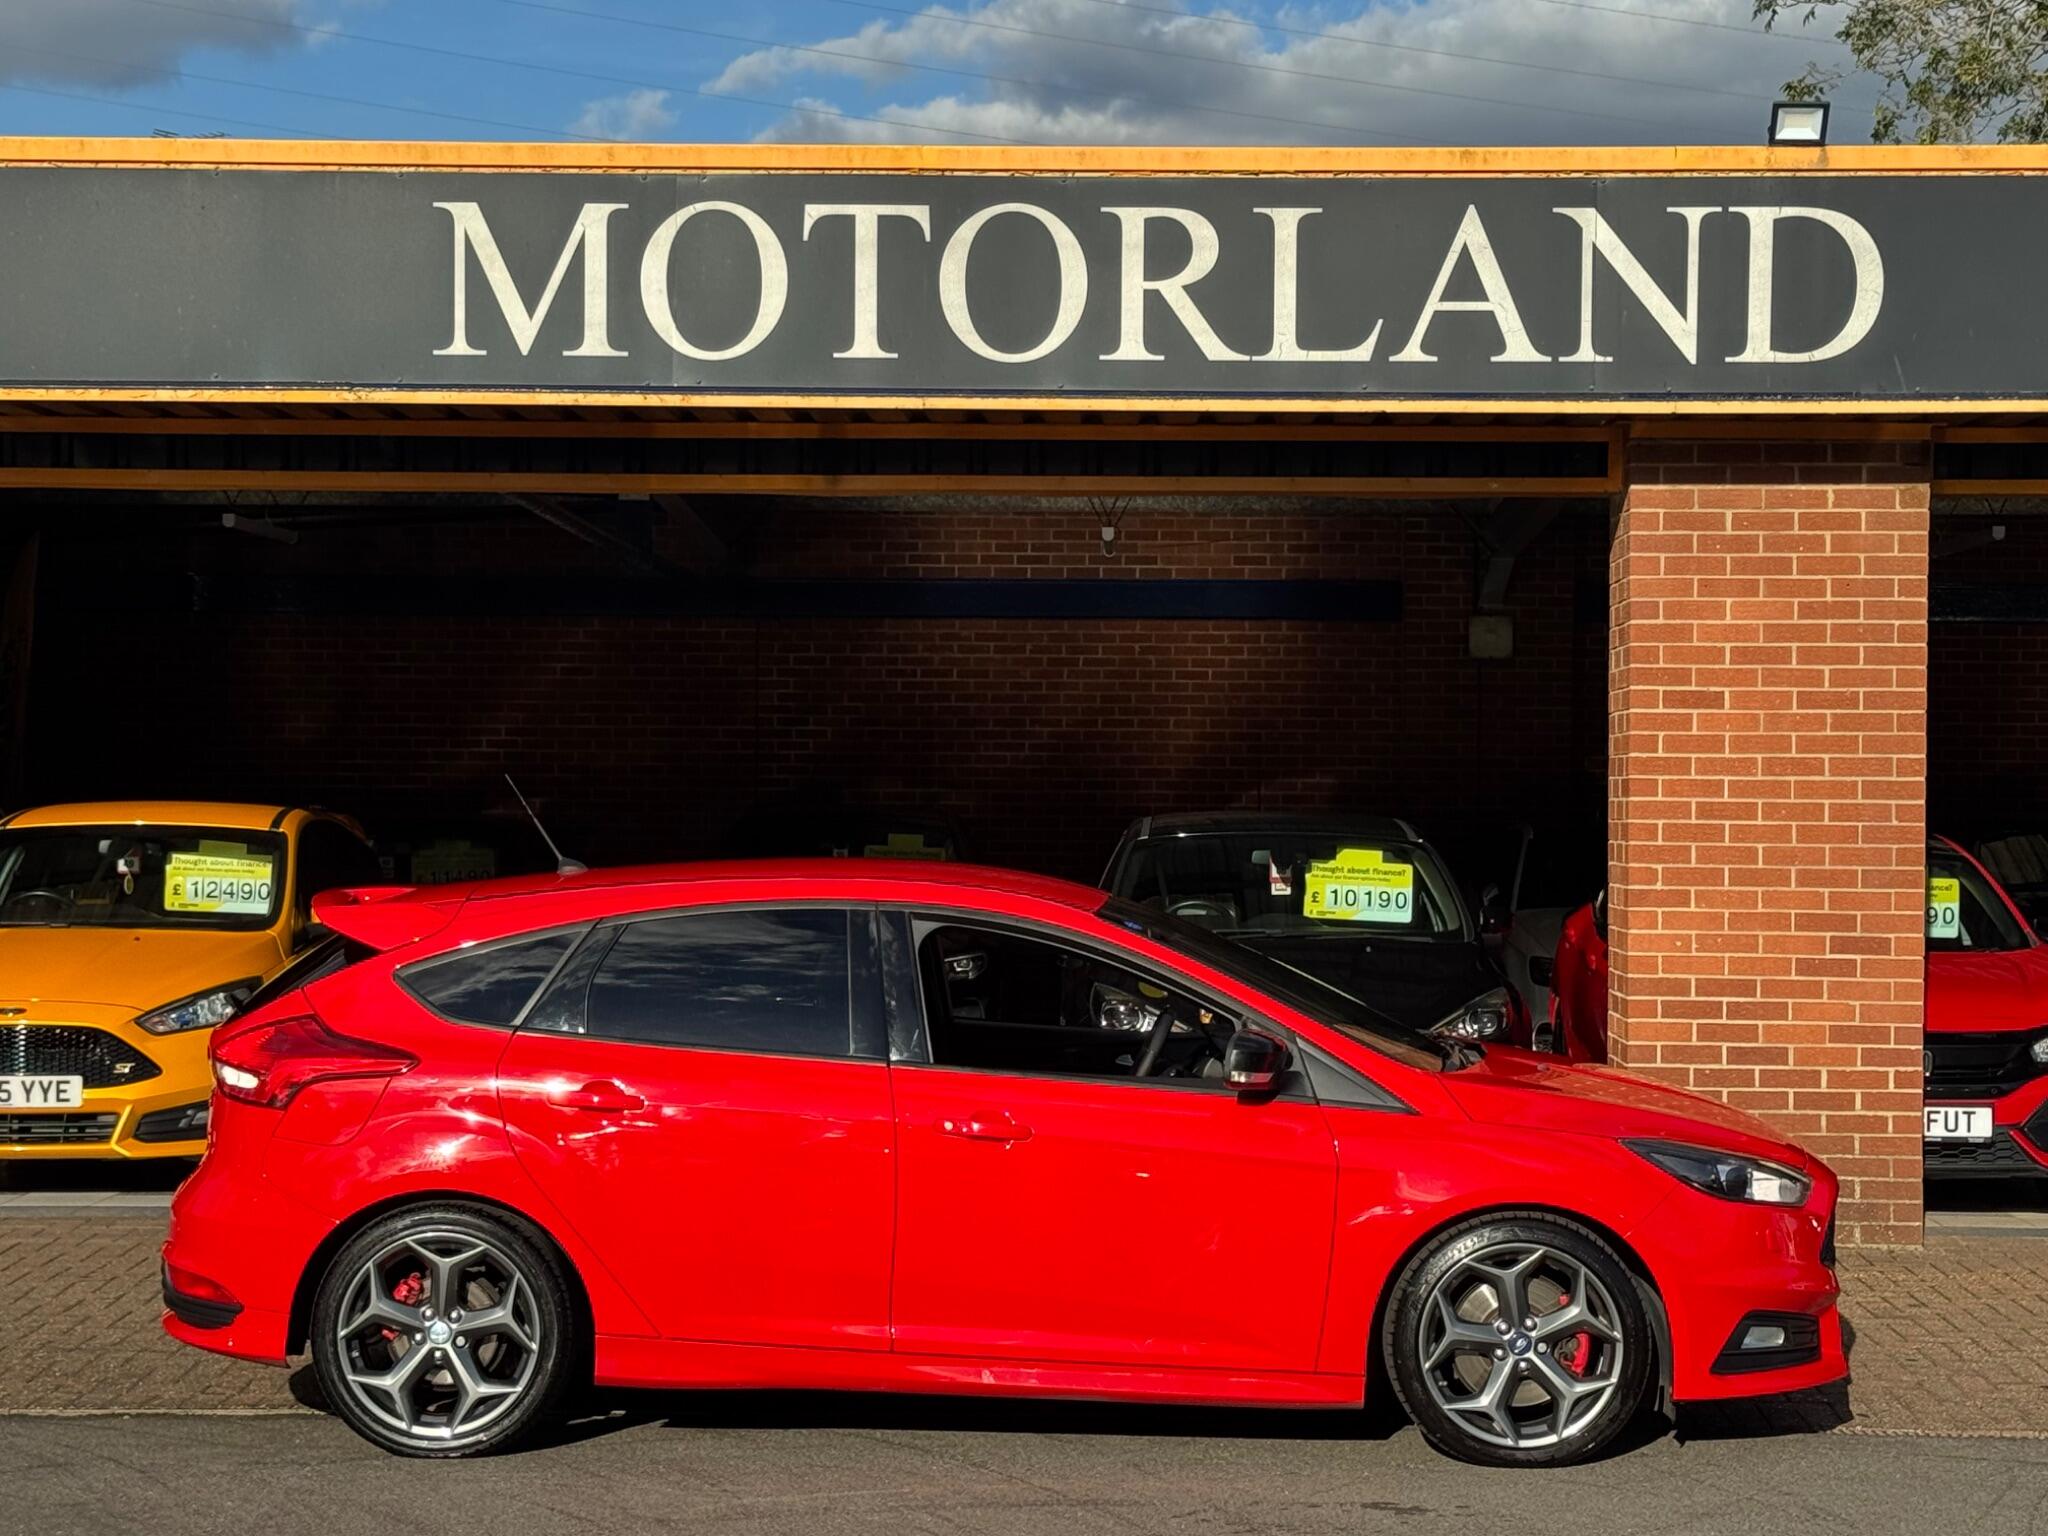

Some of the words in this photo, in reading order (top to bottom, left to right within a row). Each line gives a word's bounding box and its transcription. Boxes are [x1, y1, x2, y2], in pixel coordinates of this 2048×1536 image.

[432, 200, 1884, 365] MOTORLAND
[1312, 864, 1345, 875] Thought
[1347, 866, 1371, 875] about
[1372, 867, 1407, 878] finance?
[172, 883, 182, 896] £
[190, 880, 271, 901] 12490
[1311, 891, 1320, 904] £
[1330, 888, 1408, 910] 10190
[21, 1080, 71, 1103] YYE
[1926, 1110, 1977, 1134] FUT
